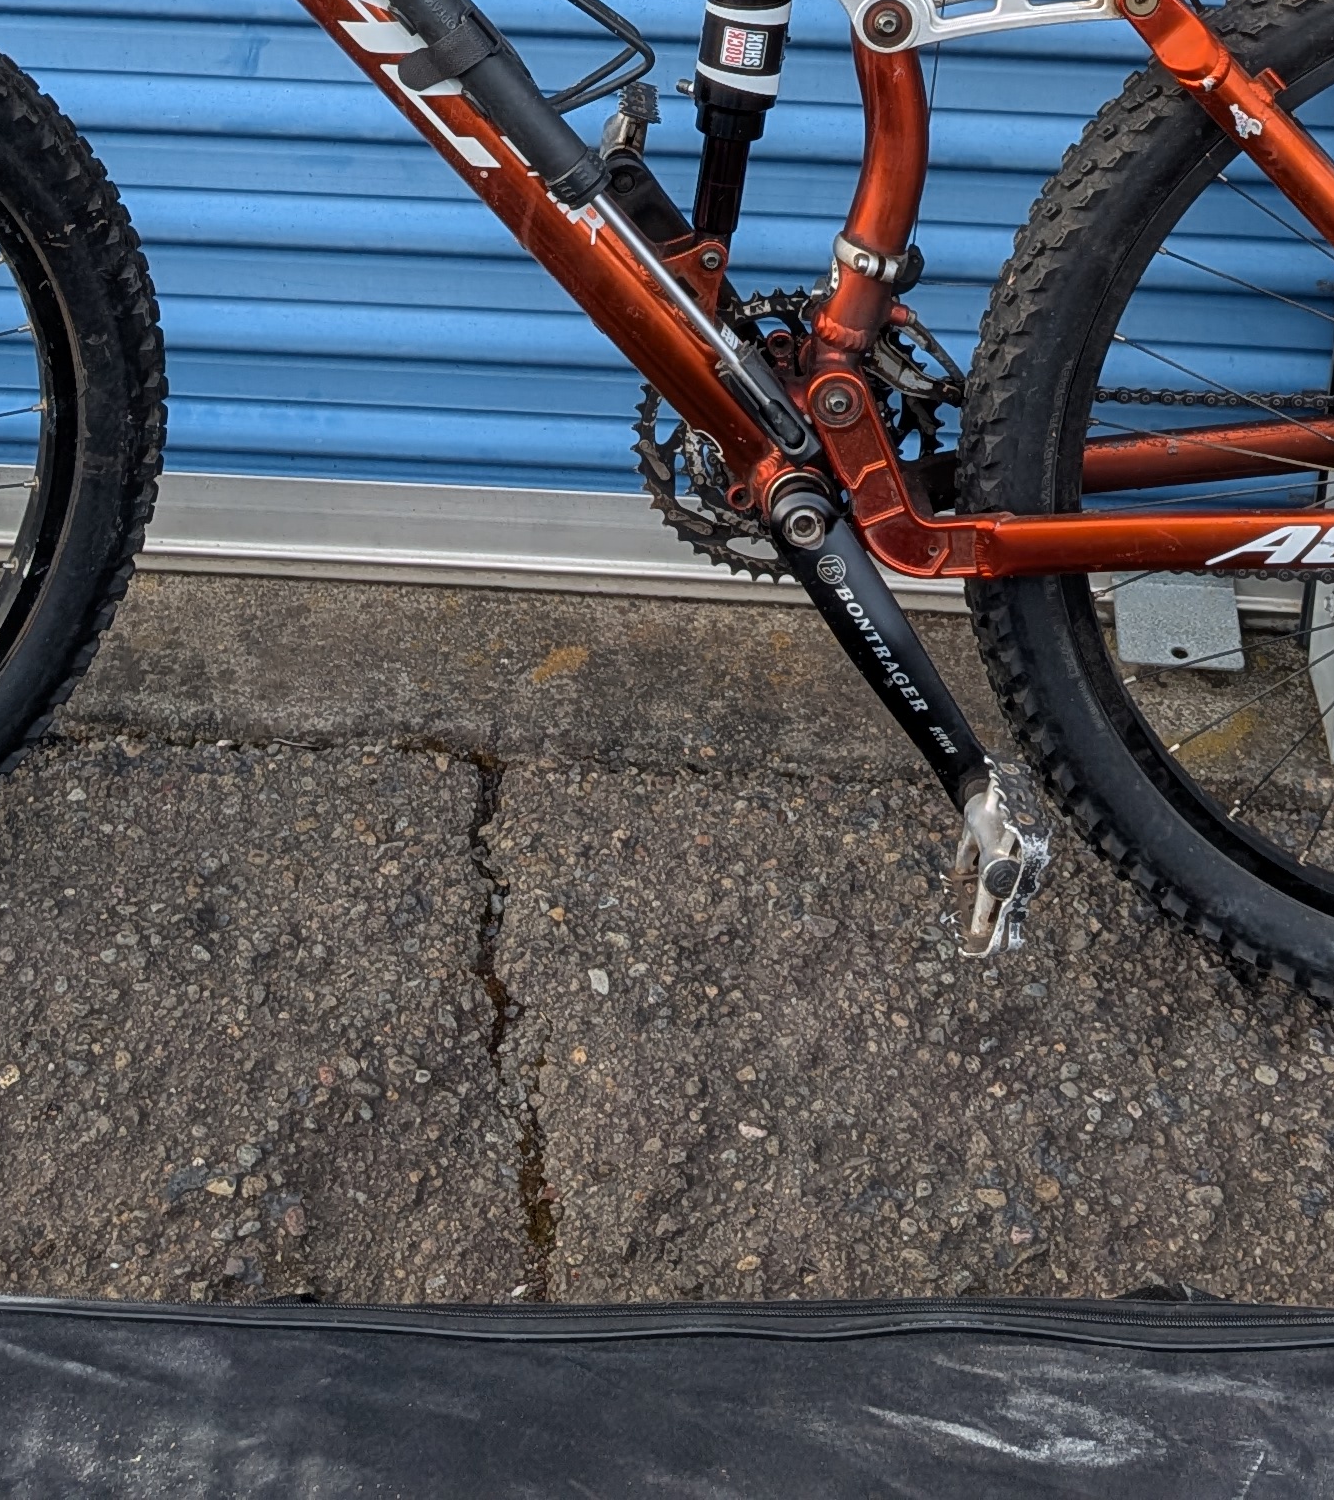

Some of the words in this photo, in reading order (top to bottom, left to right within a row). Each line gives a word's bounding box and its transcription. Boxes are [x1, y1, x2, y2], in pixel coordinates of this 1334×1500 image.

[724, 30, 745, 64] ROCK
[743, 33, 765, 67] SHOX
[835, 587, 929, 712] BONTRAGER
